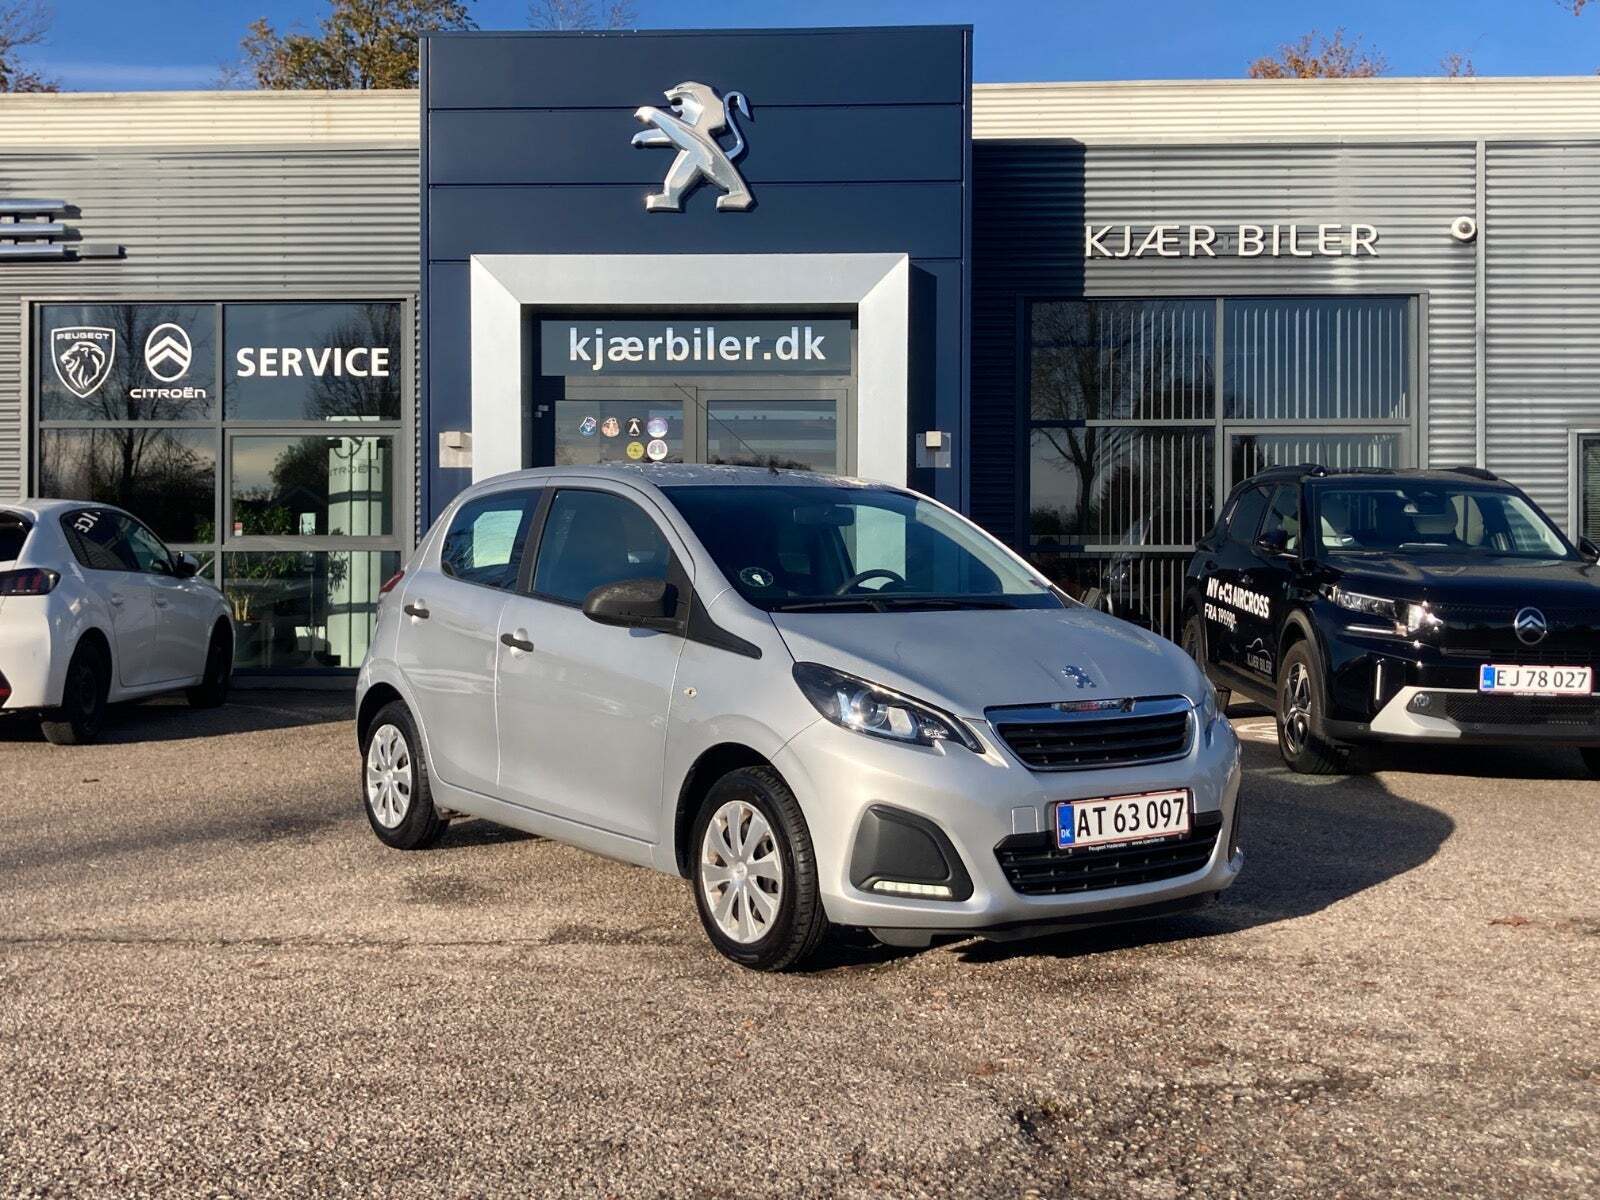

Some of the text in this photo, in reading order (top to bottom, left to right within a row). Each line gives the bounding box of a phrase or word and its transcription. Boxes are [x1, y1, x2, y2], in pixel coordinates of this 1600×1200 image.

[1086, 223, 1379, 257] KJÆR BILER
[56, 332, 110, 340] PEUGEOT
[569, 326, 826, 371] kjærbiler.dk
[236, 347, 390, 378] SERVICE
[1204, 603, 1217, 621] FRA
[1206, 577, 1270, 619] NY e-C3 AIRCROSS
[1497, 670, 1587, 688] EJ 78 027
[1060, 827, 1071, 838] DK
[1077, 798, 1184, 837] AT 63 097
